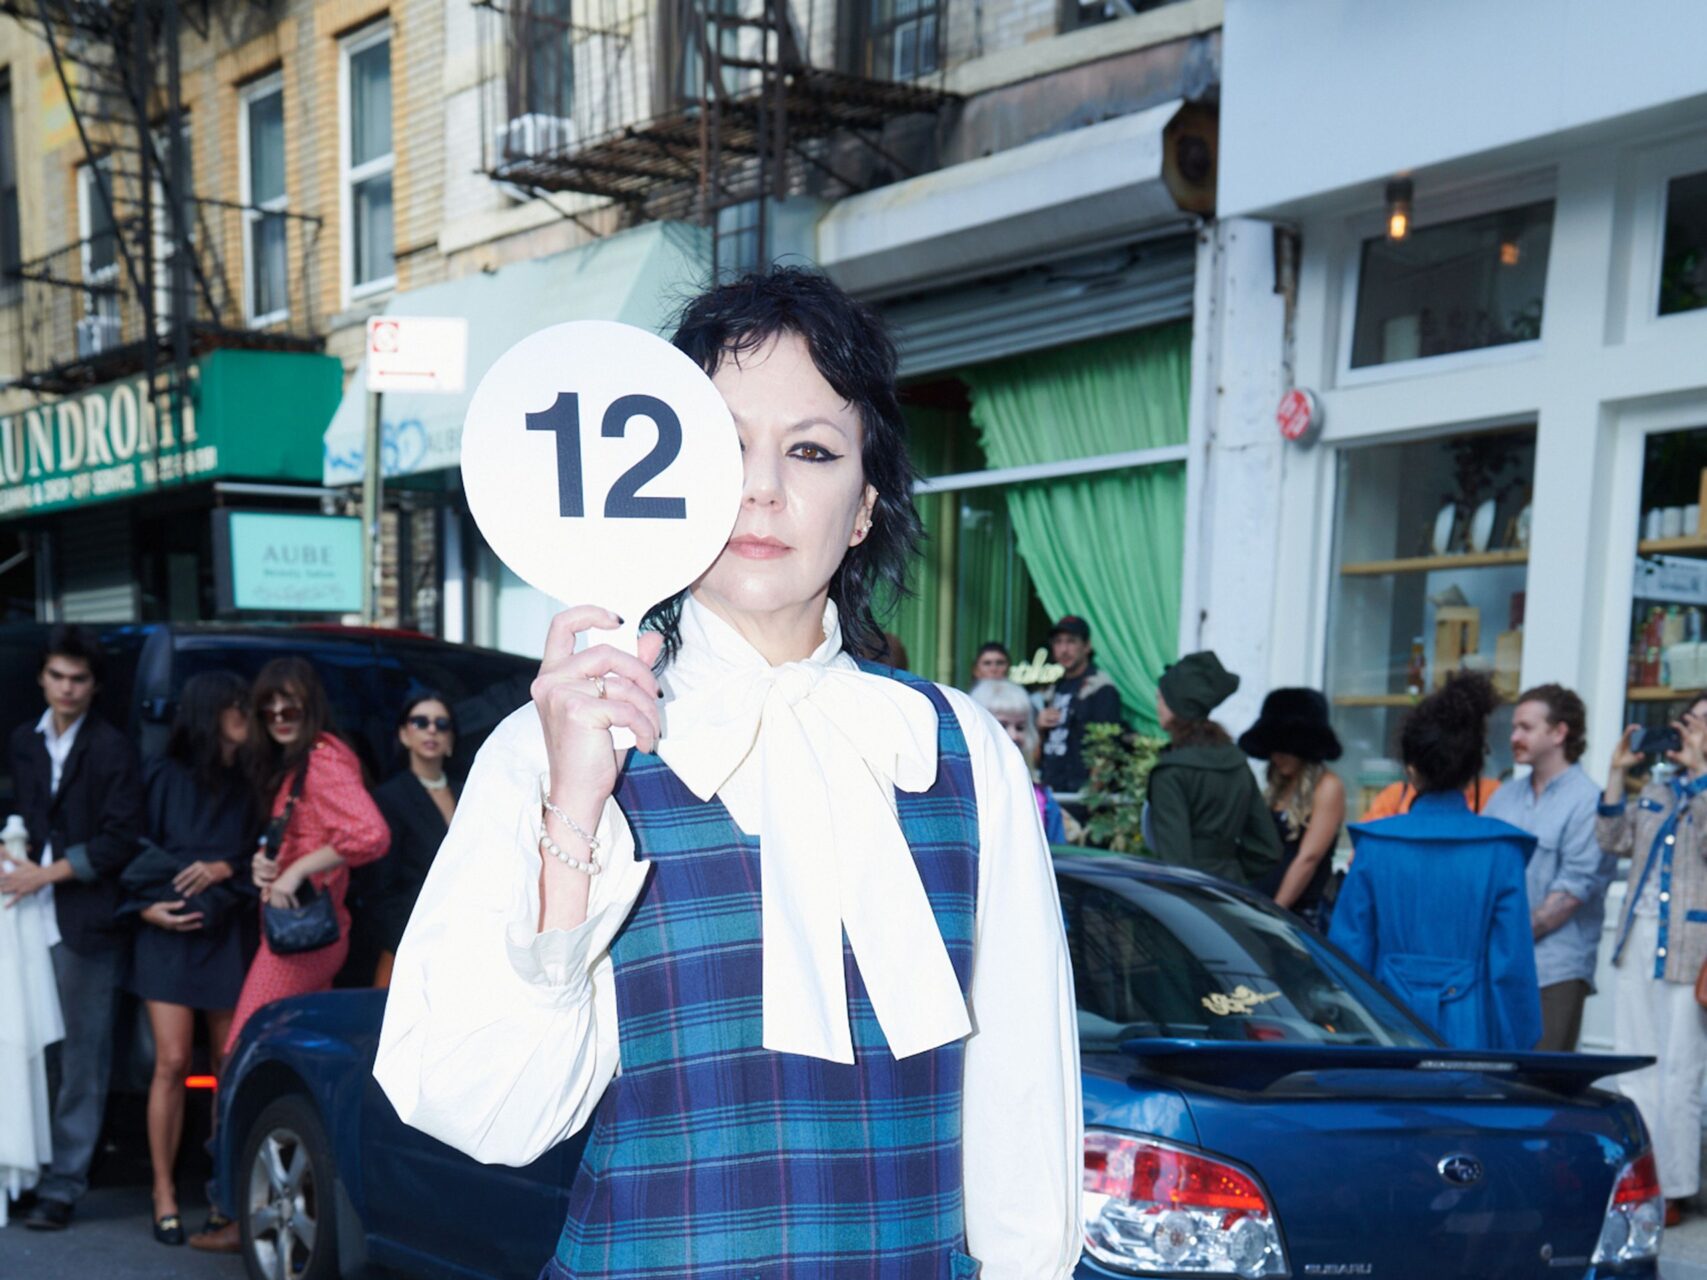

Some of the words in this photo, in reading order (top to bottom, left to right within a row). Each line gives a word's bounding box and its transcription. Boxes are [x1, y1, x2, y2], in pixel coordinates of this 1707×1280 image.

[525, 391, 687, 519] 12
[262, 543, 334, 566] AUBE
[1304, 1263, 1373, 1275] SUBARU
